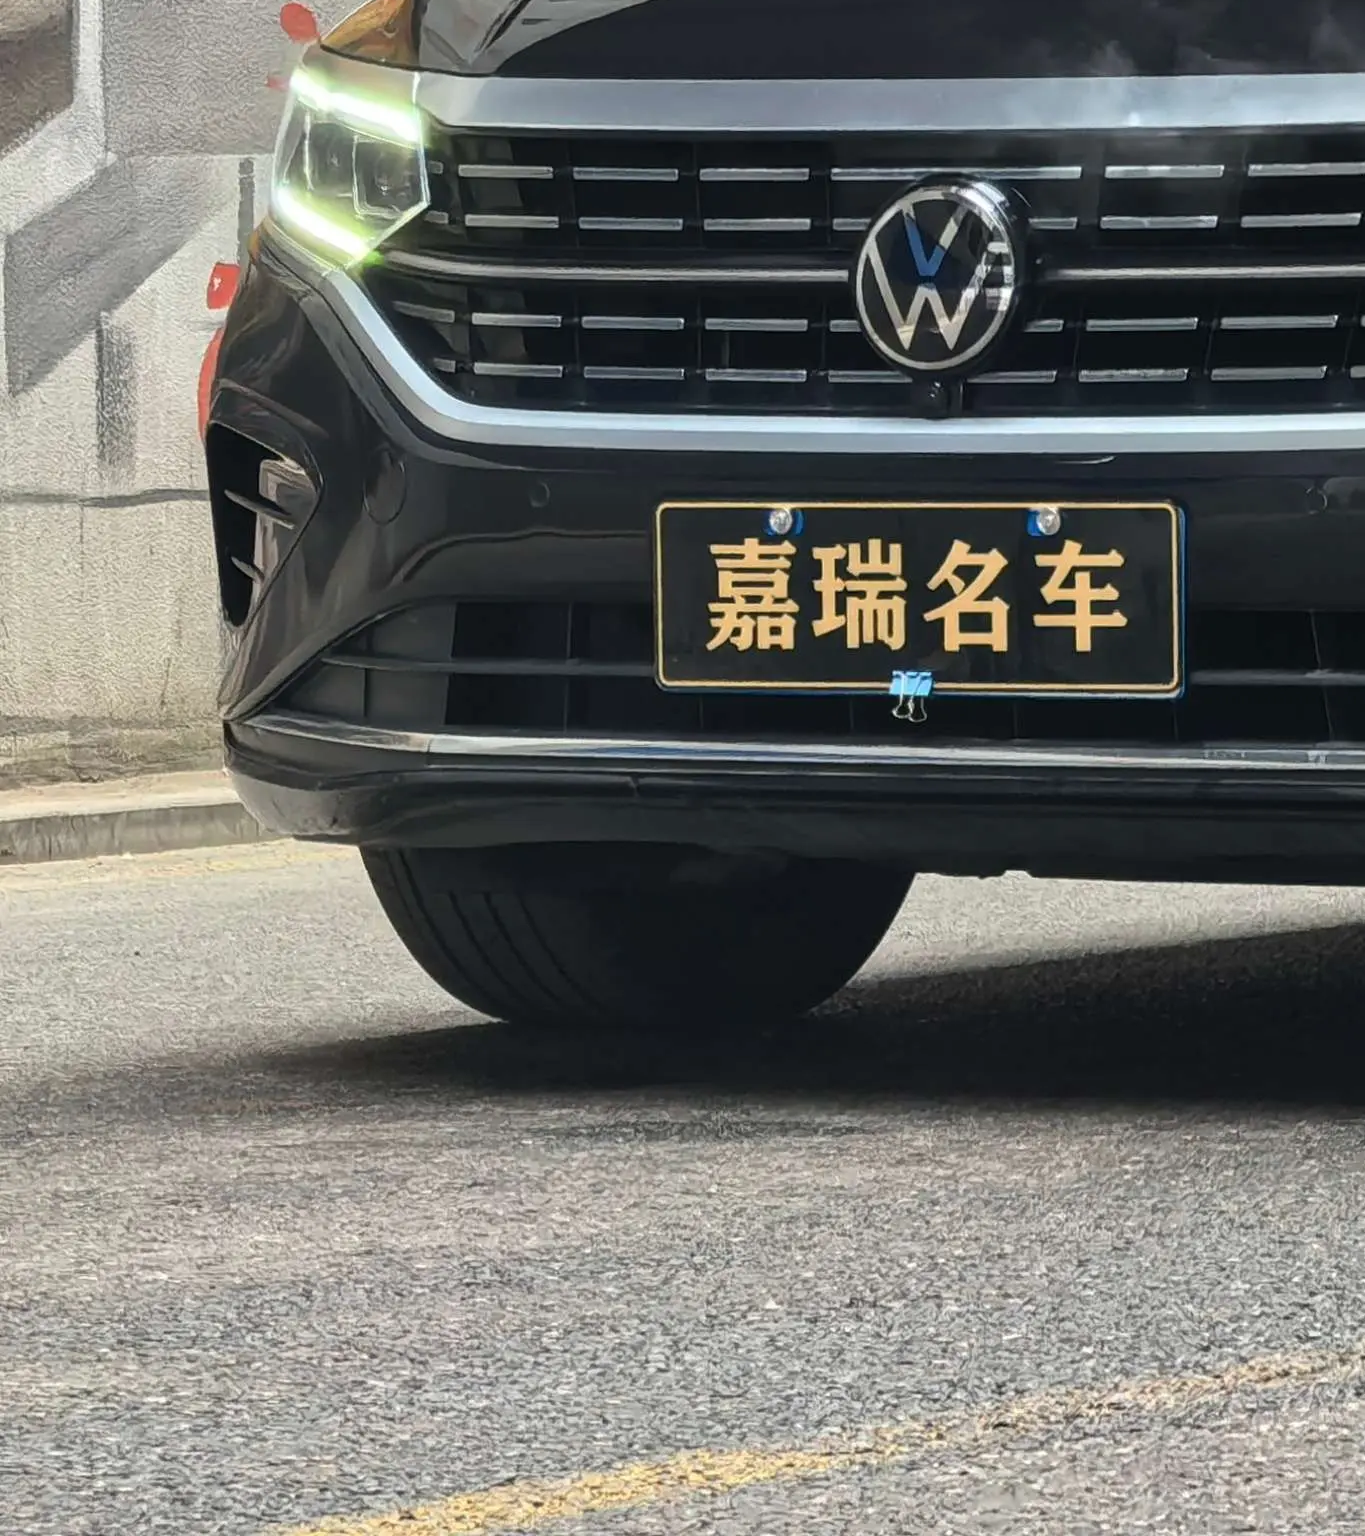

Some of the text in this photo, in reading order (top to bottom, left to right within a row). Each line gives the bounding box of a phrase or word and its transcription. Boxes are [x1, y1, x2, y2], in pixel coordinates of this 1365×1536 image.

[862, 196, 1003, 353] VW
[706, 538, 1128, 652] 嘉瑞名车
